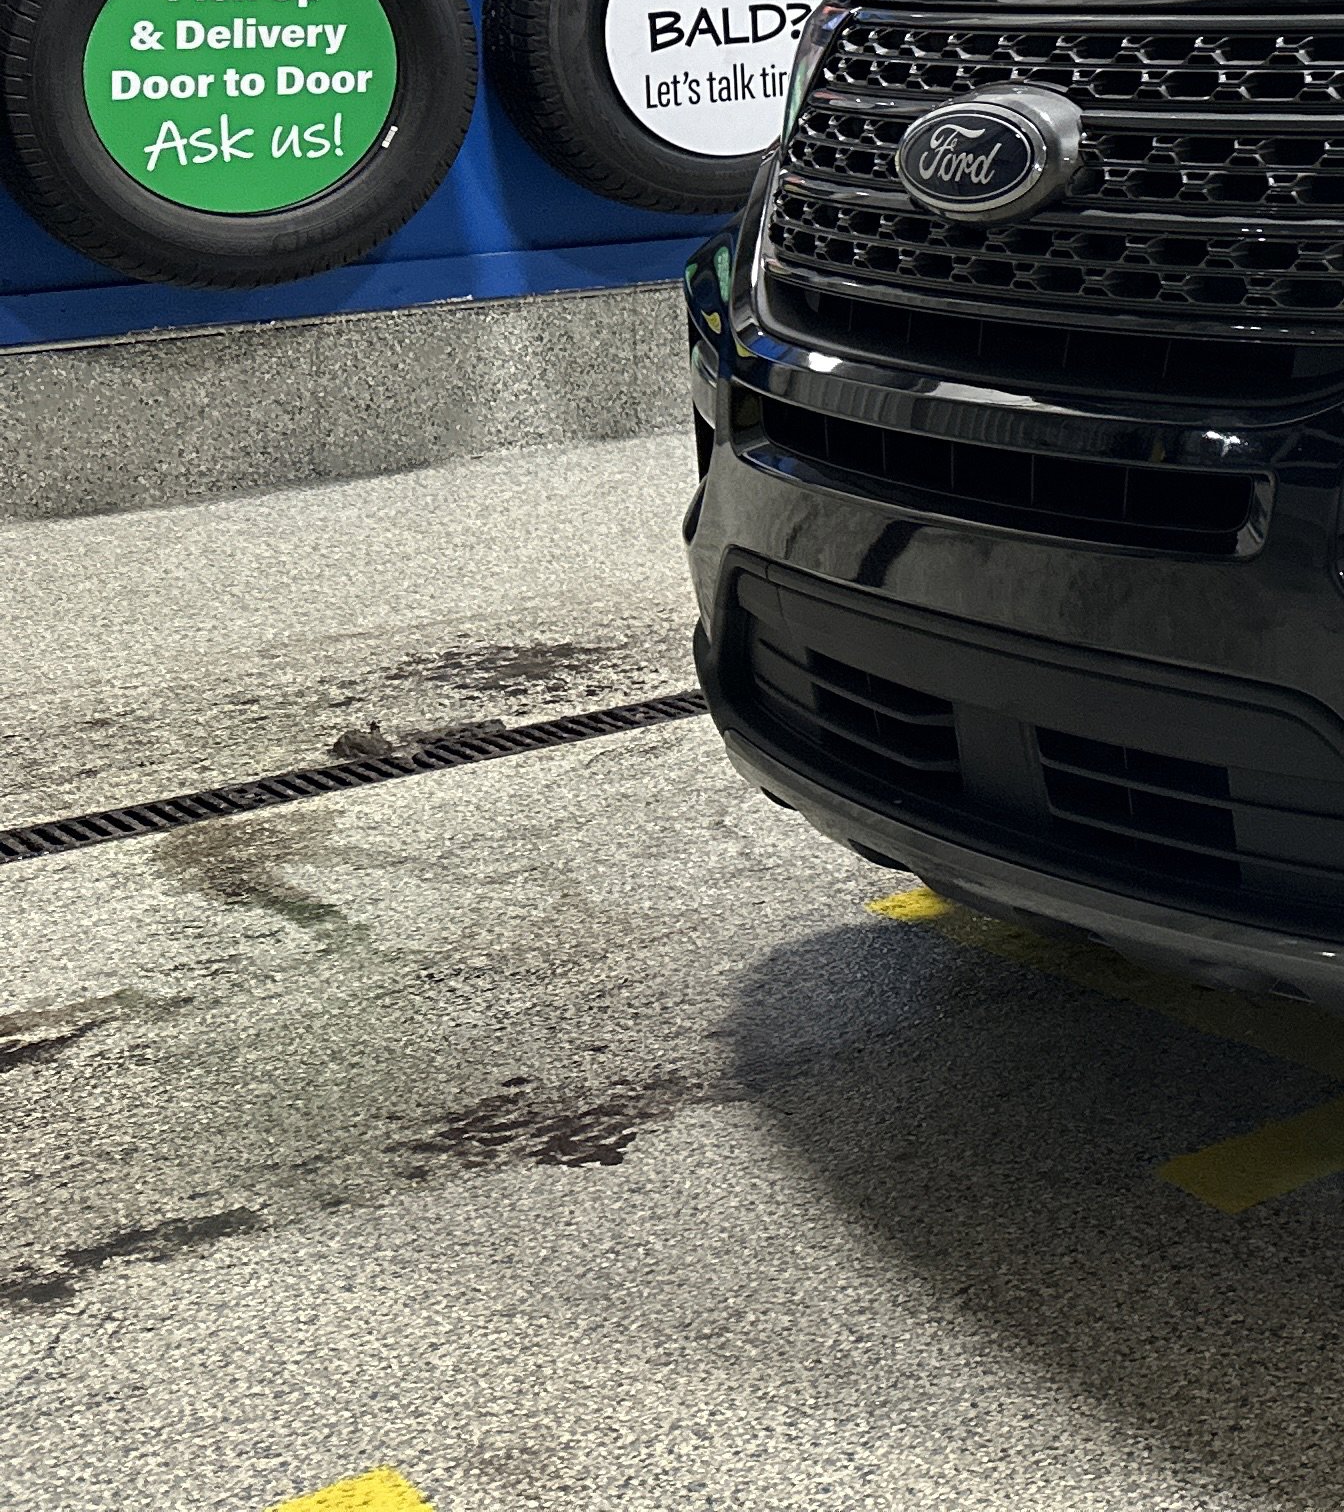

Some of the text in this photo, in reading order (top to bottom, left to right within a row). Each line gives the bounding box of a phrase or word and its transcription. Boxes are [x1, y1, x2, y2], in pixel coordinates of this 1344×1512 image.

[130, 18, 348, 55] & Delivery
[648, 3, 813, 53] BALD?
[111, 65, 373, 101] Door to Door
[645, 63, 790, 109] Let's talk tir
[144, 112, 344, 172] Ask us!
[918, 123, 1003, 185] Ford
